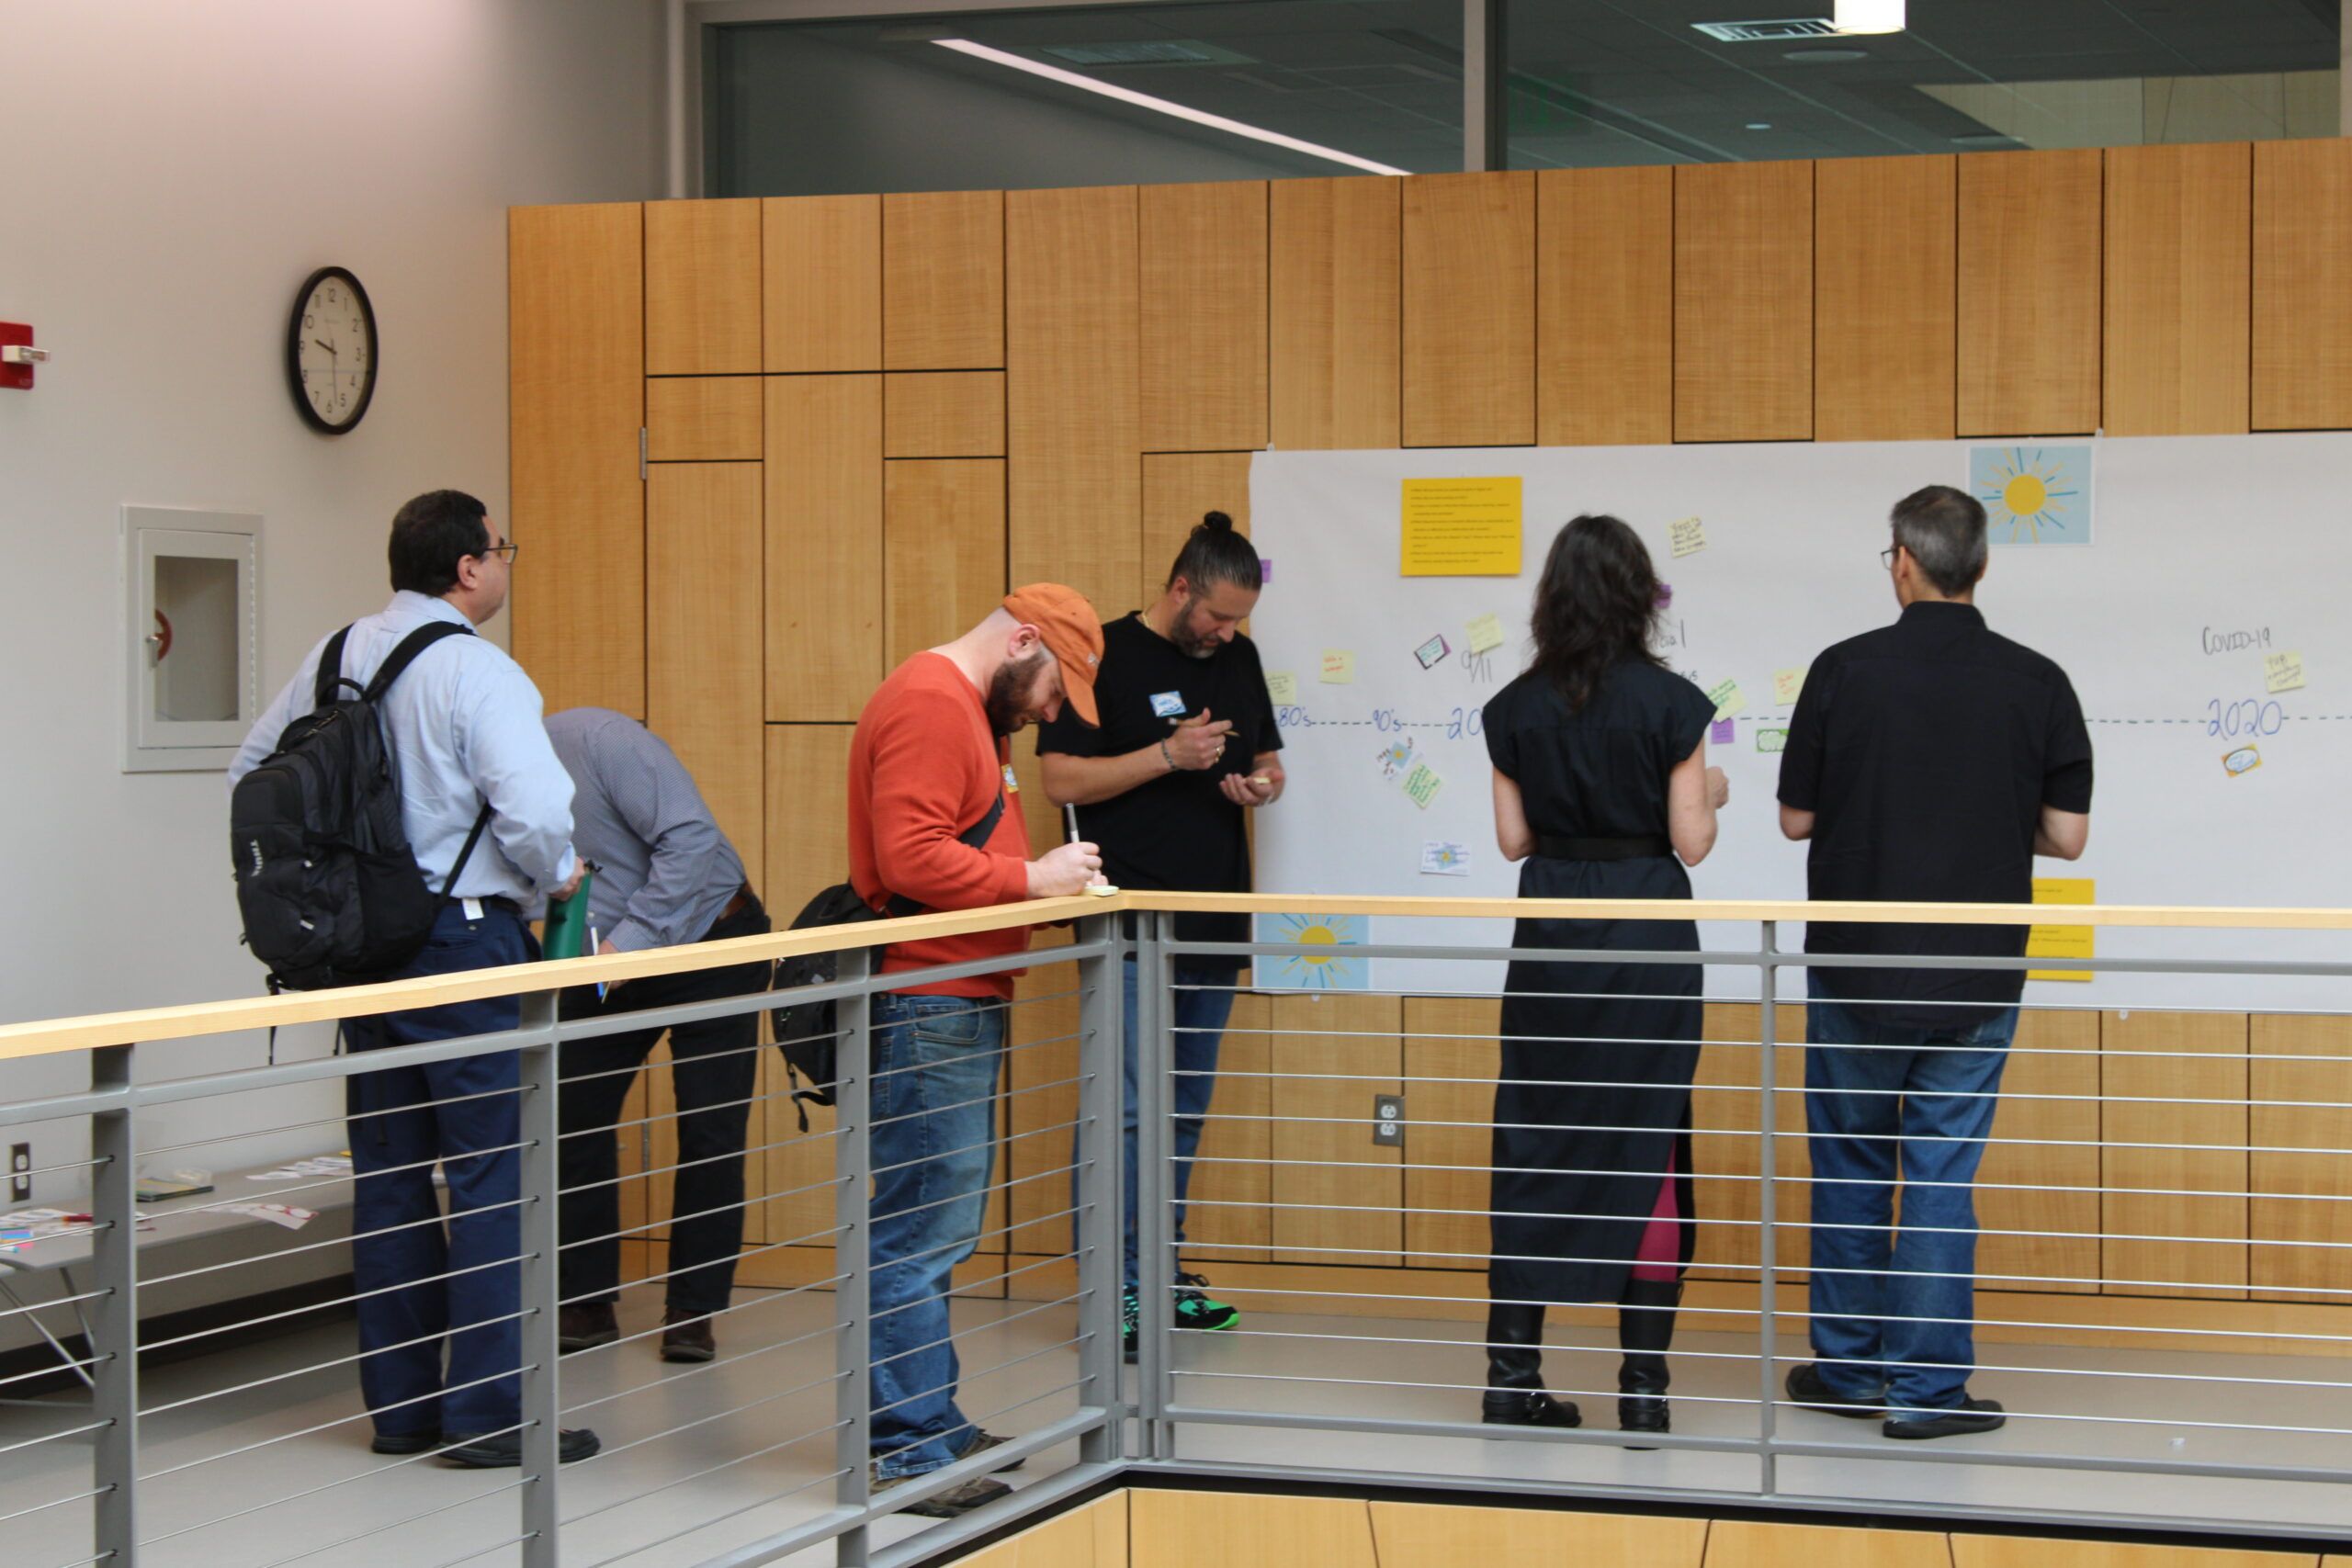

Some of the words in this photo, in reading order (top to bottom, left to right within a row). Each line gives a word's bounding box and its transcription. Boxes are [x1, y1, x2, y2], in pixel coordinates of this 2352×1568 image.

[2202, 626, 2271, 655] COVID-19
[1461, 649, 1492, 683] 9/11
[1278, 706, 1312, 727] 80's
[1373, 708, 1403, 732] 90's
[1448, 707, 1482, 739] 20
[2207, 699, 2282, 740] 2020
